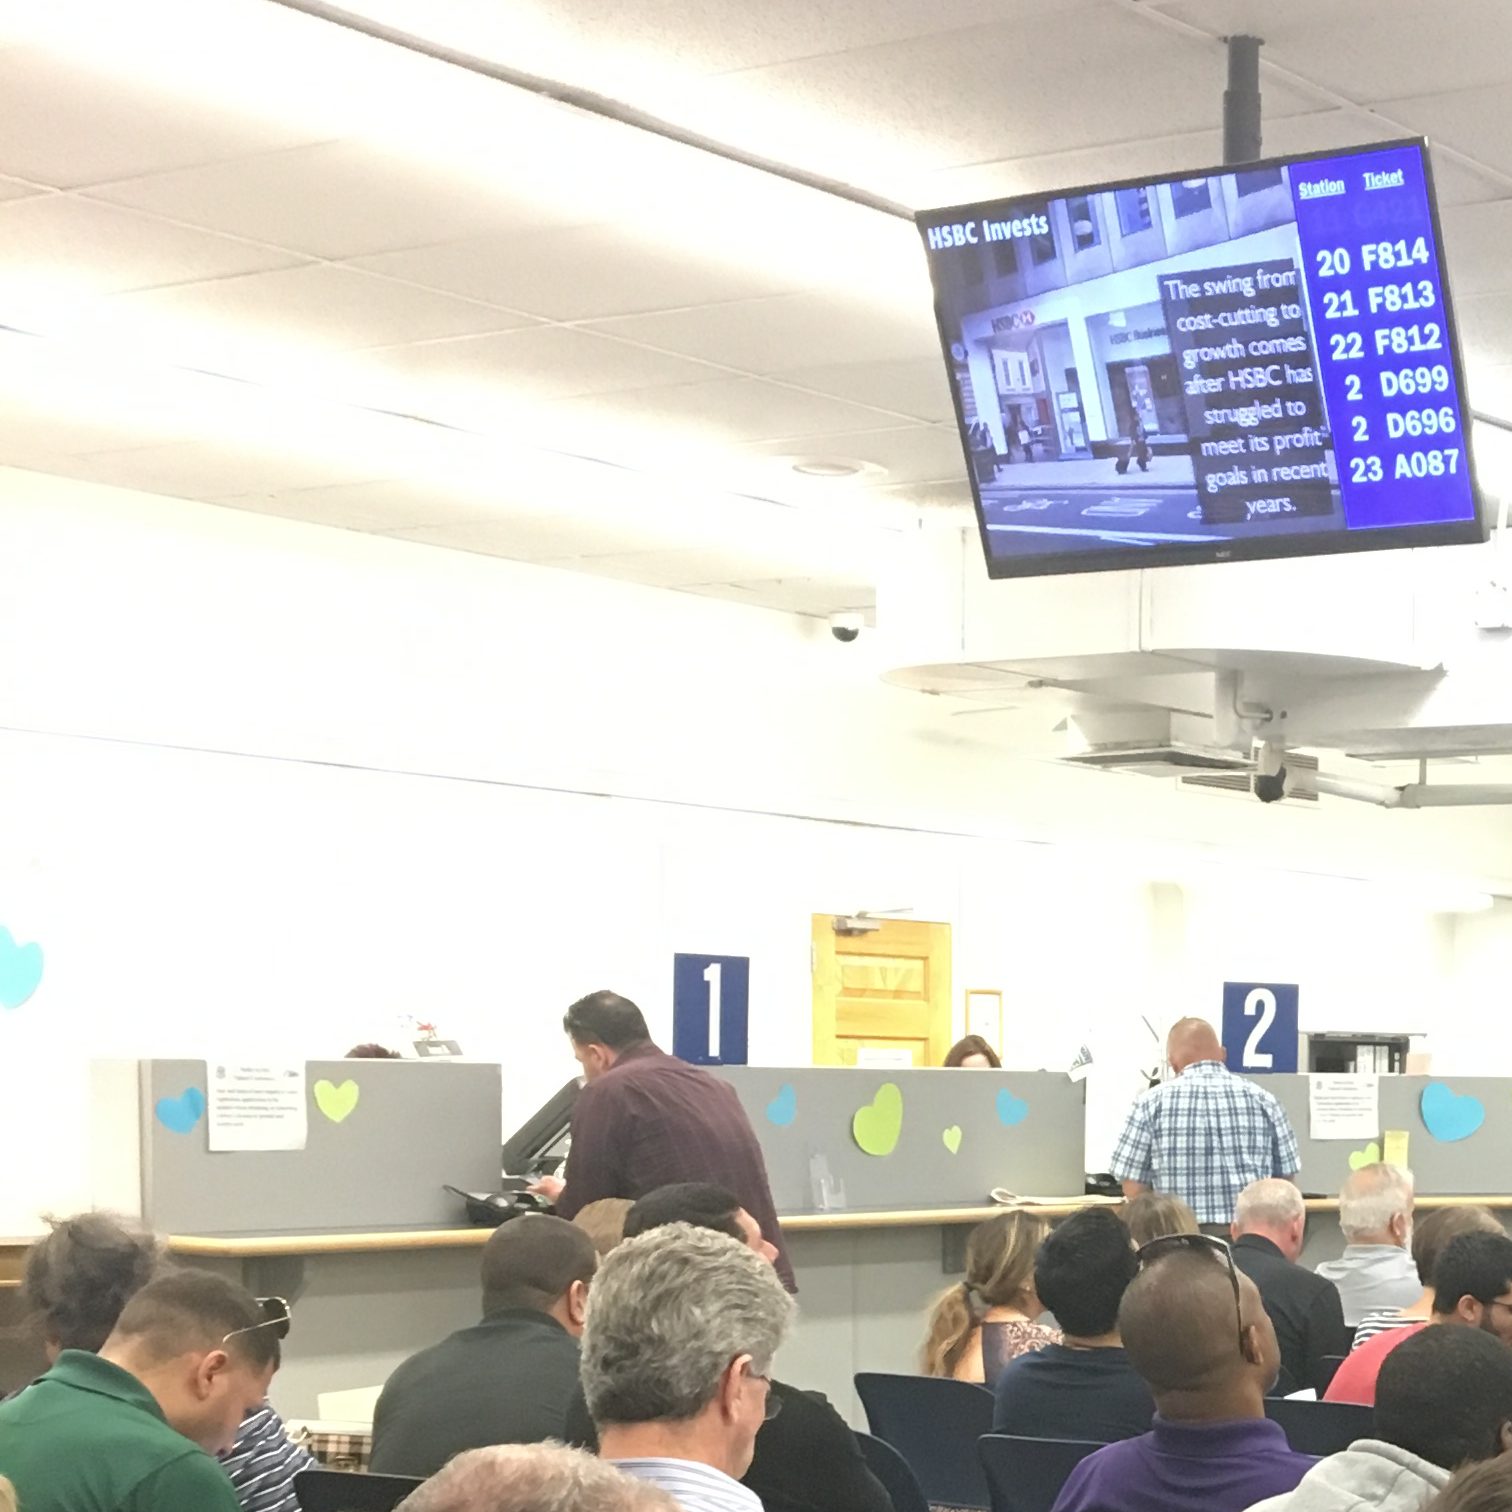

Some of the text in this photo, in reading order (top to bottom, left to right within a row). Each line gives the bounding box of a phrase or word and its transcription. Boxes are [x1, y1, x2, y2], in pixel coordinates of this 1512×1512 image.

[1298, 168, 1405, 200] Station Ticket
[927, 213, 1049, 250] HSBC Invests
[1316, 236, 1430, 277] 20 F814
[1164, 279, 1200, 300] The
[1203, 274, 1256, 297] swing
[1323, 280, 1436, 319] 21 F813
[1177, 303, 1301, 332] cost-cutting to
[1182, 335, 1307, 369] growth comes
[1330, 322, 1442, 361] 22 F812
[1184, 363, 1313, 395] after HSBC has
[1344, 364, 1449, 401] 2 D699
[1203, 397, 1306, 427] struggled to
[1351, 406, 1456, 442] 2 D696
[1201, 426, 1323, 457] meet its profit
[1205, 465, 1248, 493] goals
[1251, 465, 1269, 483] in
[1350, 448, 1460, 483] 23 A087
[1245, 497, 1297, 521] years.
[703, 962, 722, 1057] 1
[1242, 987, 1277, 1068] 2
